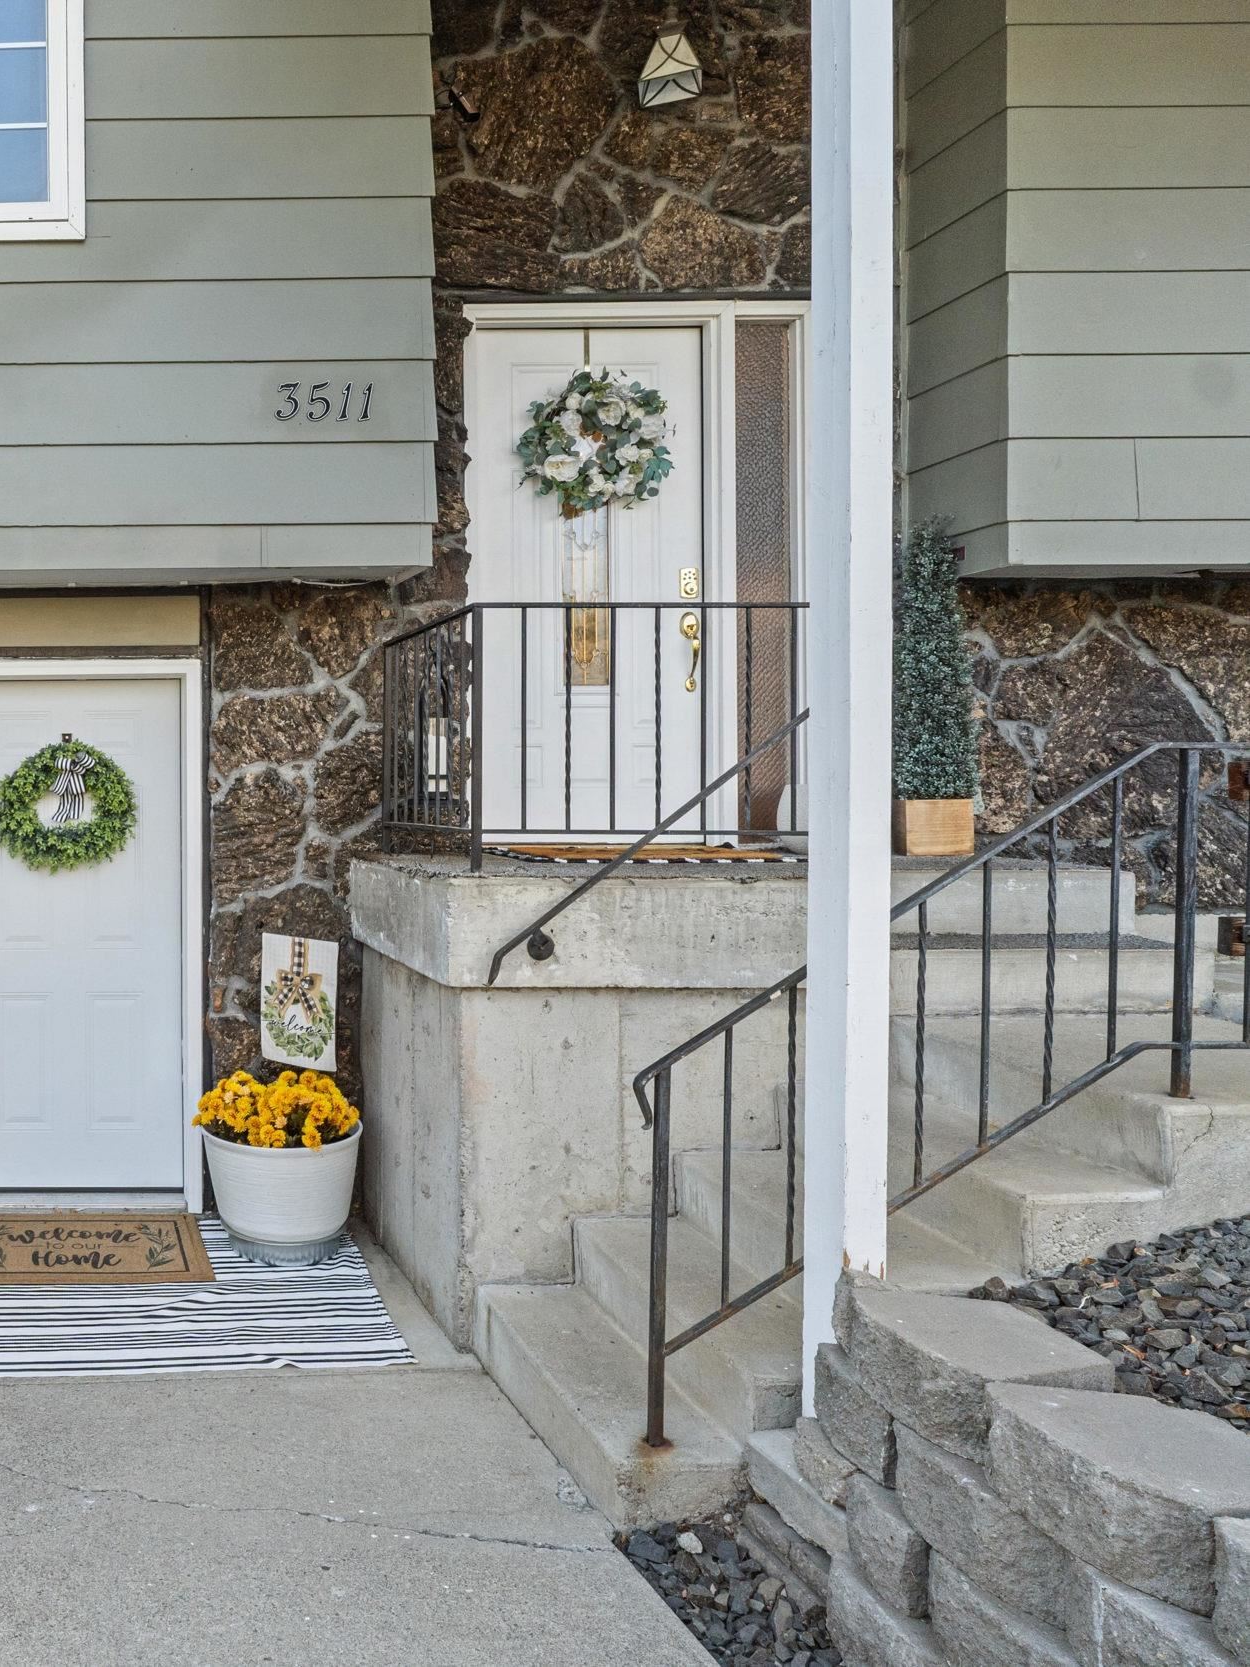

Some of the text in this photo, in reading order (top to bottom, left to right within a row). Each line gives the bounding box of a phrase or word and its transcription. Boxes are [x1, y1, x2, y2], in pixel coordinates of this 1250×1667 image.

[275, 381, 374, 422] 3511
[270, 1014, 322, 1035] welcome
[7, 1227, 141, 1244] welcome
[31, 1250, 122, 1269] Home
